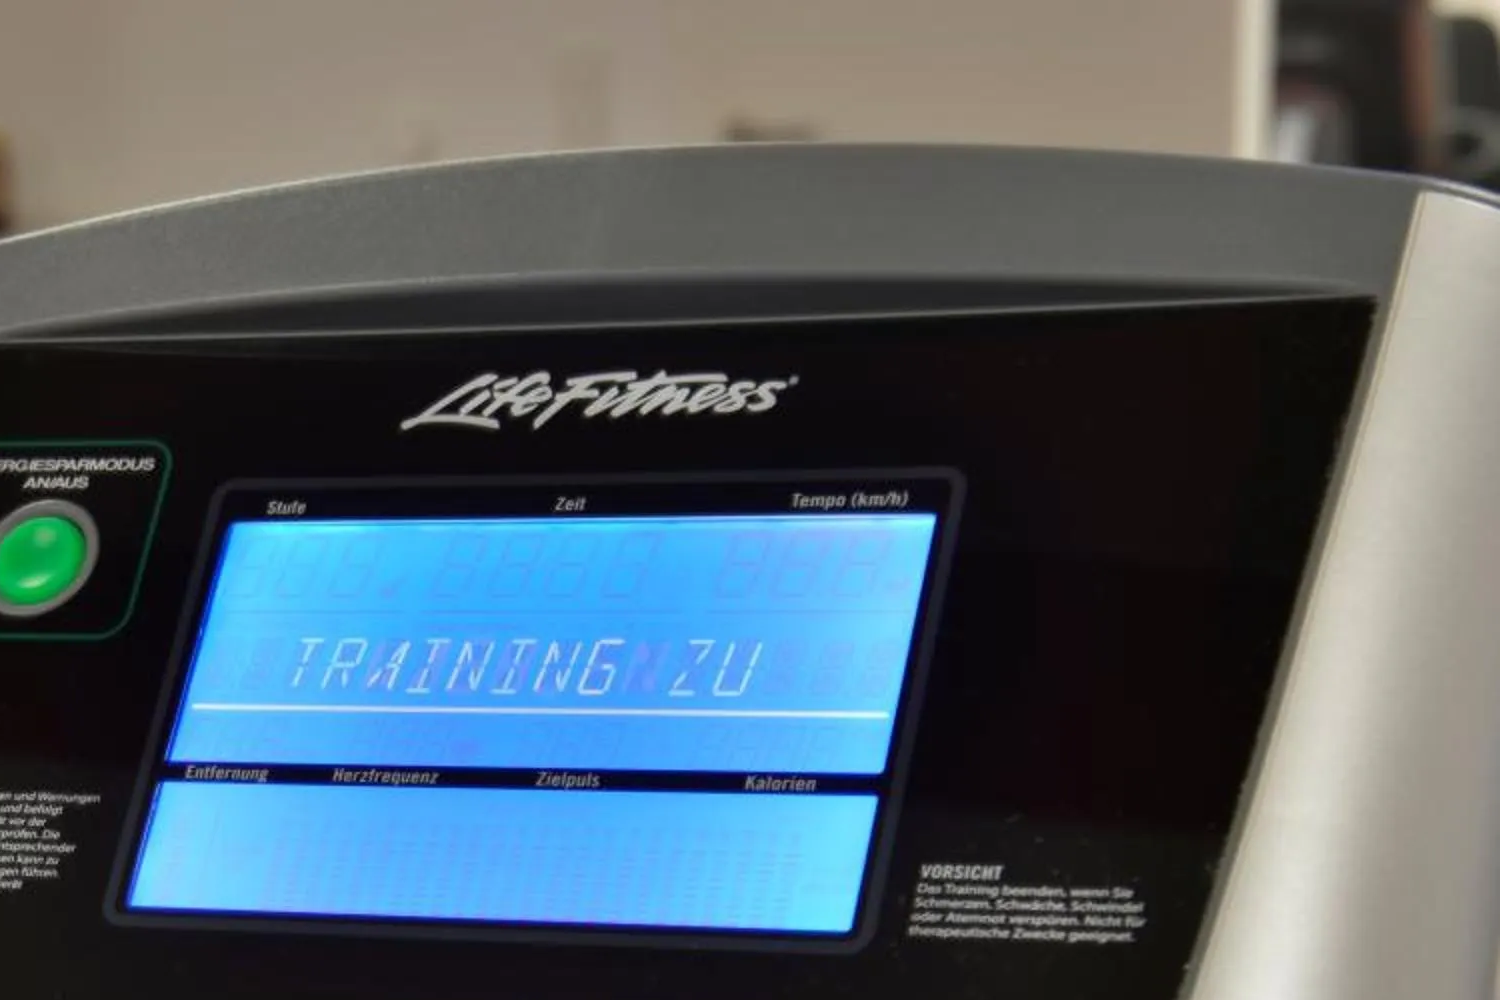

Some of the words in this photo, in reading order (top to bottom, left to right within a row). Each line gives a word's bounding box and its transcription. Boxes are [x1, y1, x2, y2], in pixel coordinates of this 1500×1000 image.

[23, 476, 90, 489] AN/AUS
[267, 500, 306, 515] Stufe
[554, 497, 586, 511] Zeit
[791, 493, 846, 511] Tempo
[851, 491, 909, 508] (km/h)
[290, 638, 626, 697] TRAINING
[668, 638, 763, 697] ZU
[185, 764, 269, 782] Entfernung
[332, 767, 440, 786] Herzfrequenz
[536, 771, 600, 789] Zielpuls
[744, 775, 817, 792] Kalorien
[920, 863, 1004, 880] VORSICHT
[944, 884, 999, 898] Training
